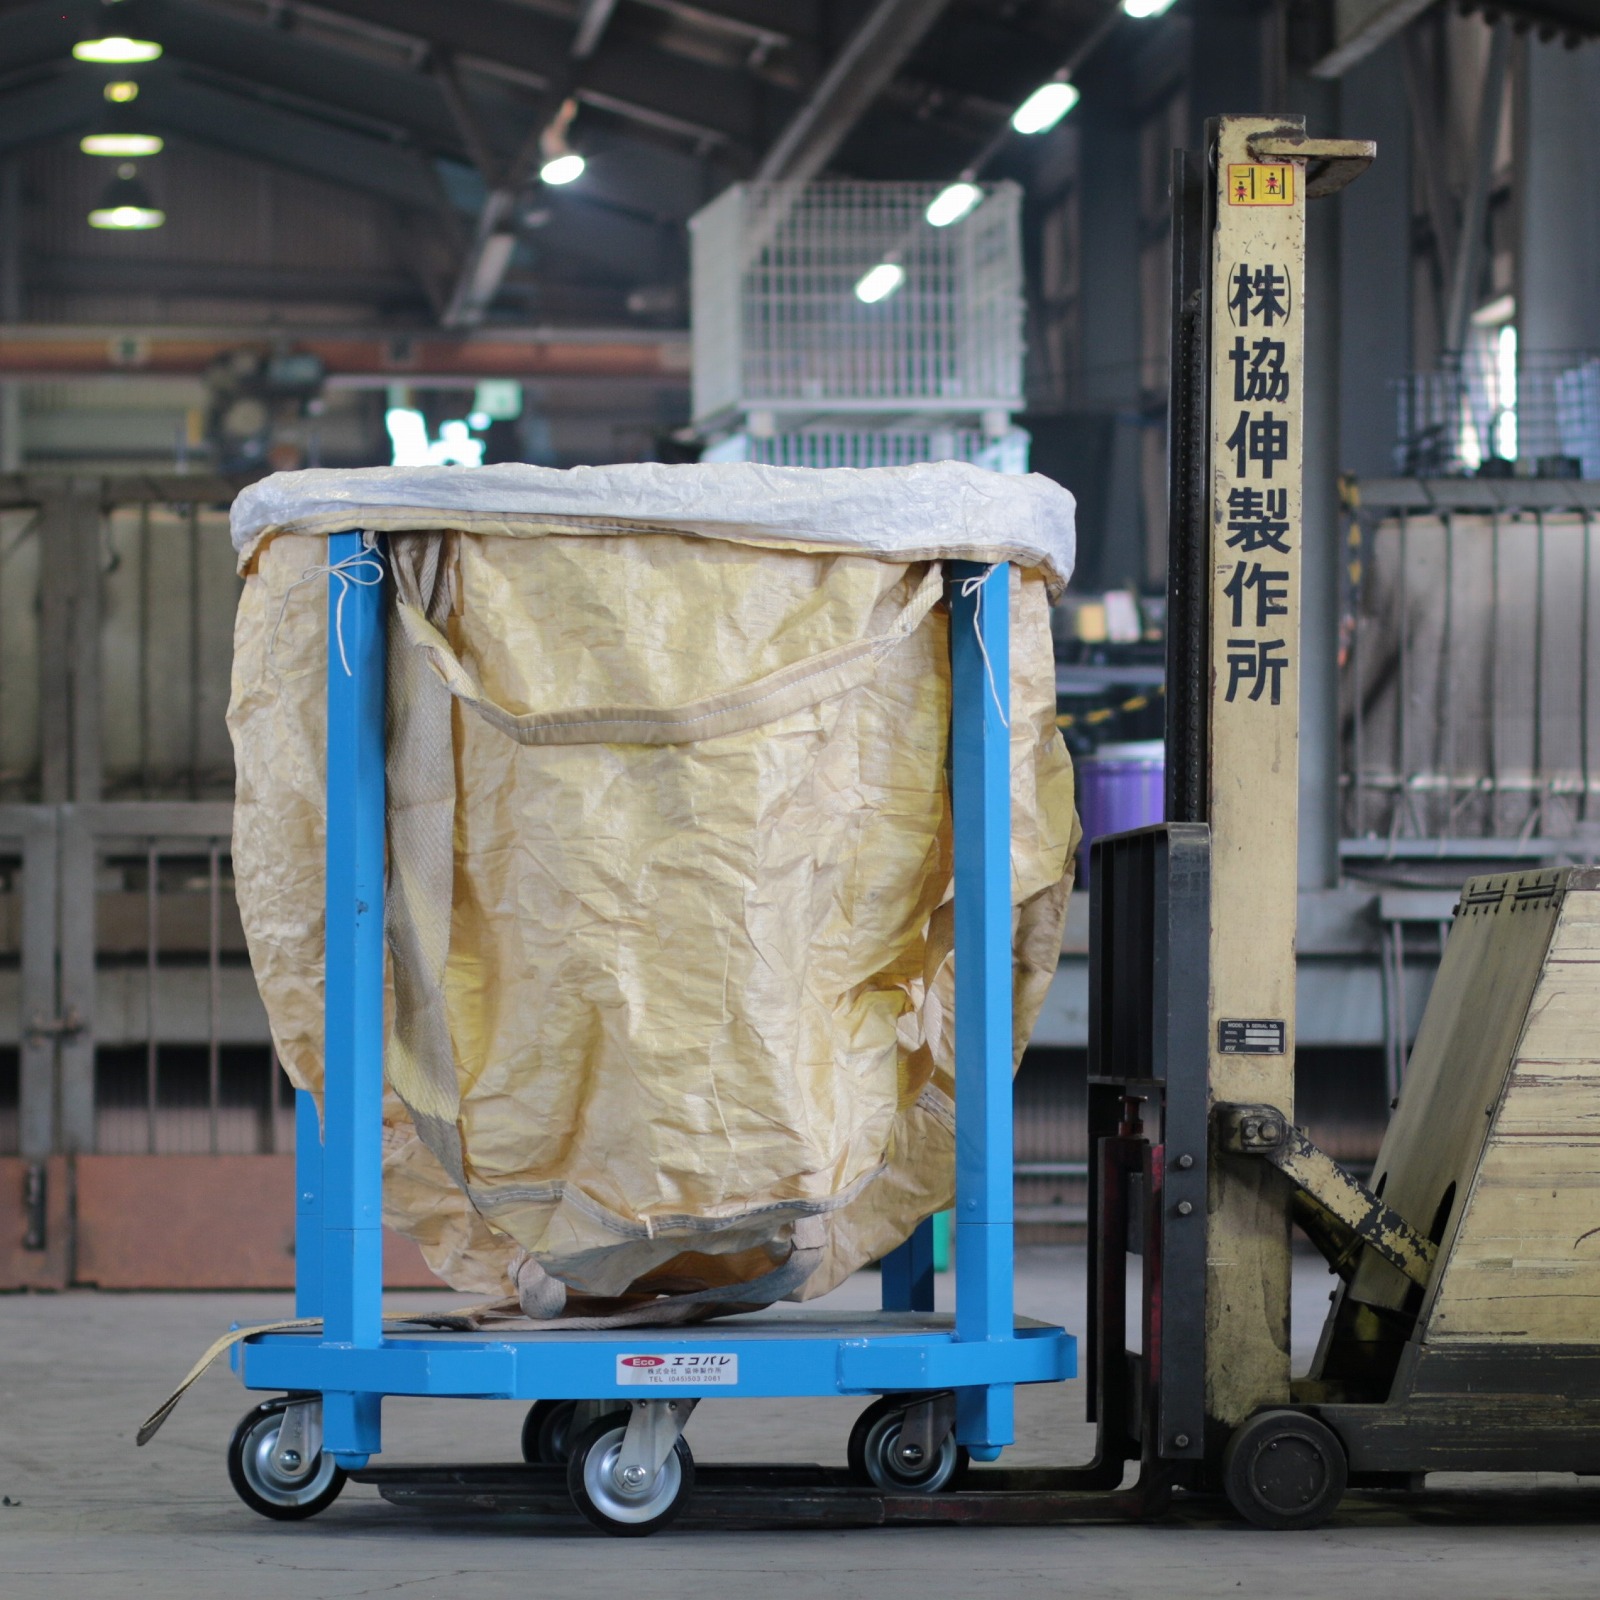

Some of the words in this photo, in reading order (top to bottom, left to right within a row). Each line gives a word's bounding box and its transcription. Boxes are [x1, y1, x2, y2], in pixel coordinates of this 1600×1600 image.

[1228, 262, 1291, 705] (株)協伸製作所
[633, 1358, 655, 1366] Eco
[647, 1367, 677, 1375] 株式会社
